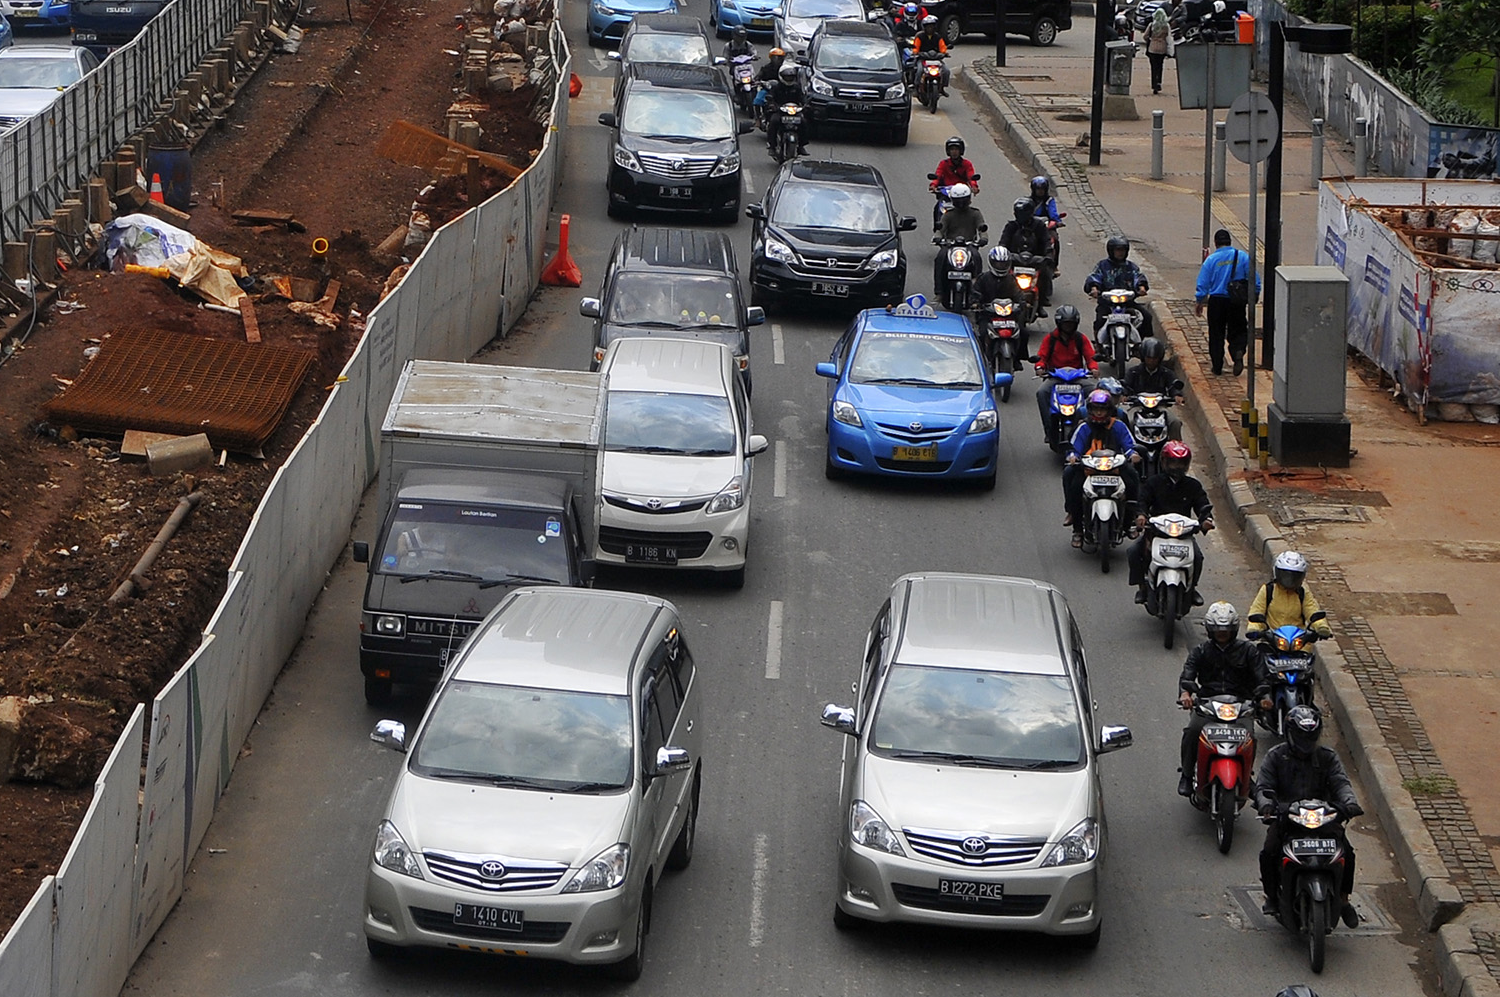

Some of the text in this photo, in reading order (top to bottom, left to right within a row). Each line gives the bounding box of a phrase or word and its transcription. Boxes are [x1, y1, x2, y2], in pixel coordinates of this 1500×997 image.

[627, 545, 677, 558] B 1186 KN
[415, 621, 476, 635] MITSU
[941, 880, 1002, 898] B 1272 PKE
[455, 904, 521, 924] B 1410 CVL
